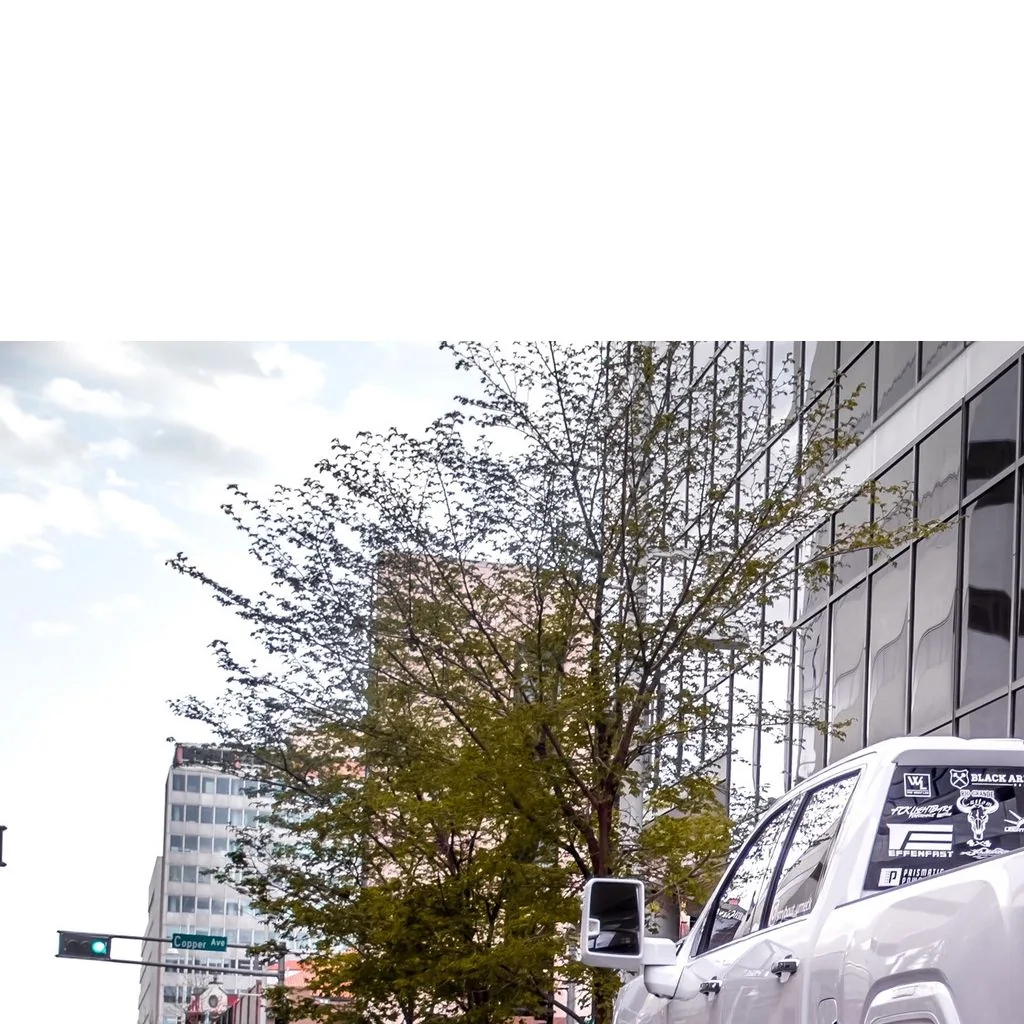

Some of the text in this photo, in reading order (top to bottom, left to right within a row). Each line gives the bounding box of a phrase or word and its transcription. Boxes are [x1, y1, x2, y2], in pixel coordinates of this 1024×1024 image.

[970, 773, 1006, 783] BLACK
[888, 850, 954, 858] EFFENFAST
[173, 935, 226, 949] Copper Ave
